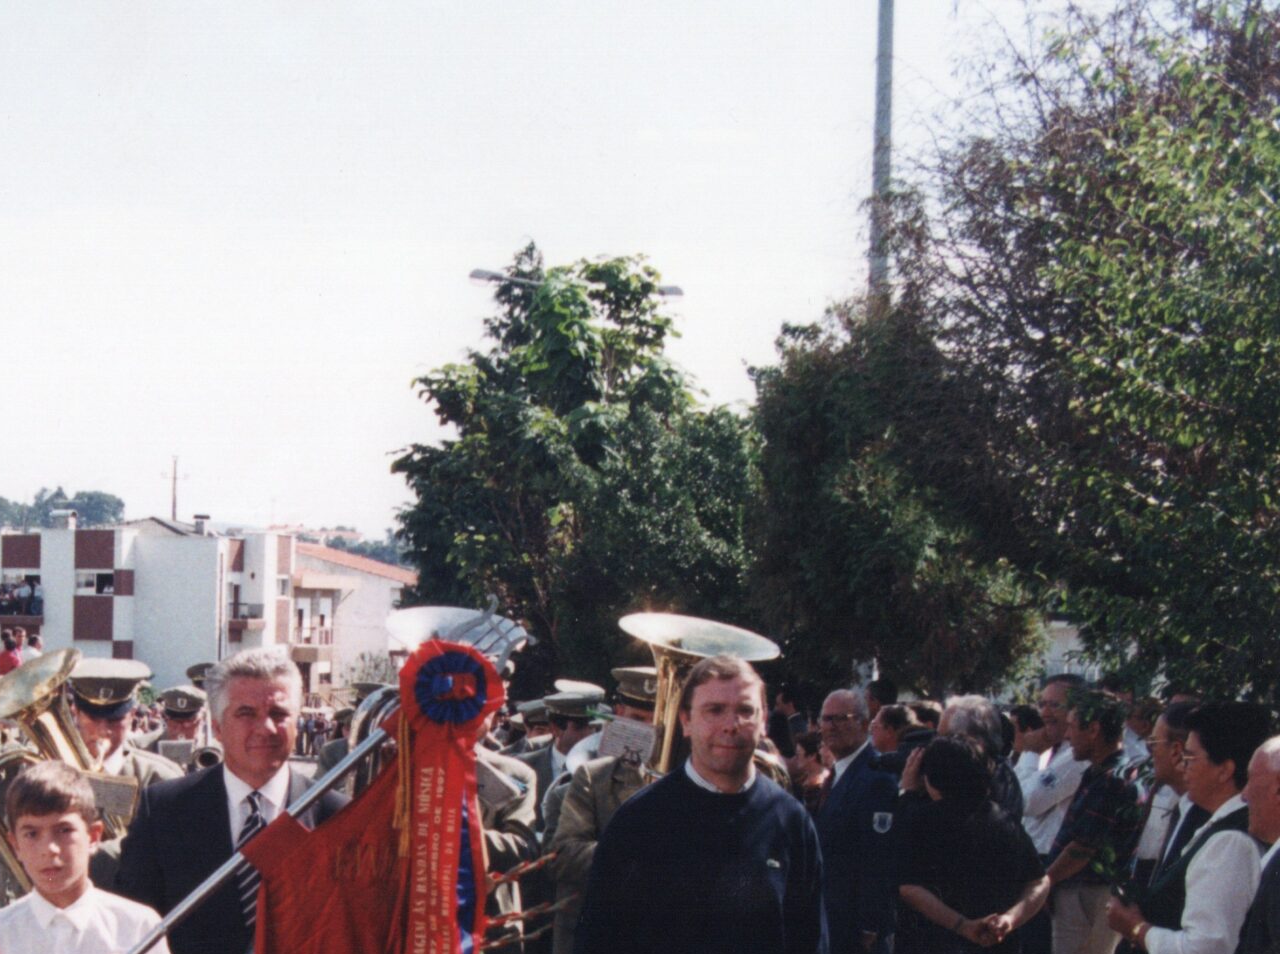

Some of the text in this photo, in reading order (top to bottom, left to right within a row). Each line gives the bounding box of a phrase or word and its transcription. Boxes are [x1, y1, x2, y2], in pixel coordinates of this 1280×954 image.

[418, 767, 434, 814] MÚSICA
[435, 766, 446, 798] 1997
[417, 821, 429, 837] DE
[433, 806, 443, 824] DE
[415, 844, 427, 893] BANDAS
[430, 832, 440, 906] SETEMBRO
[441, 864, 452, 916] MUNICIPAL
